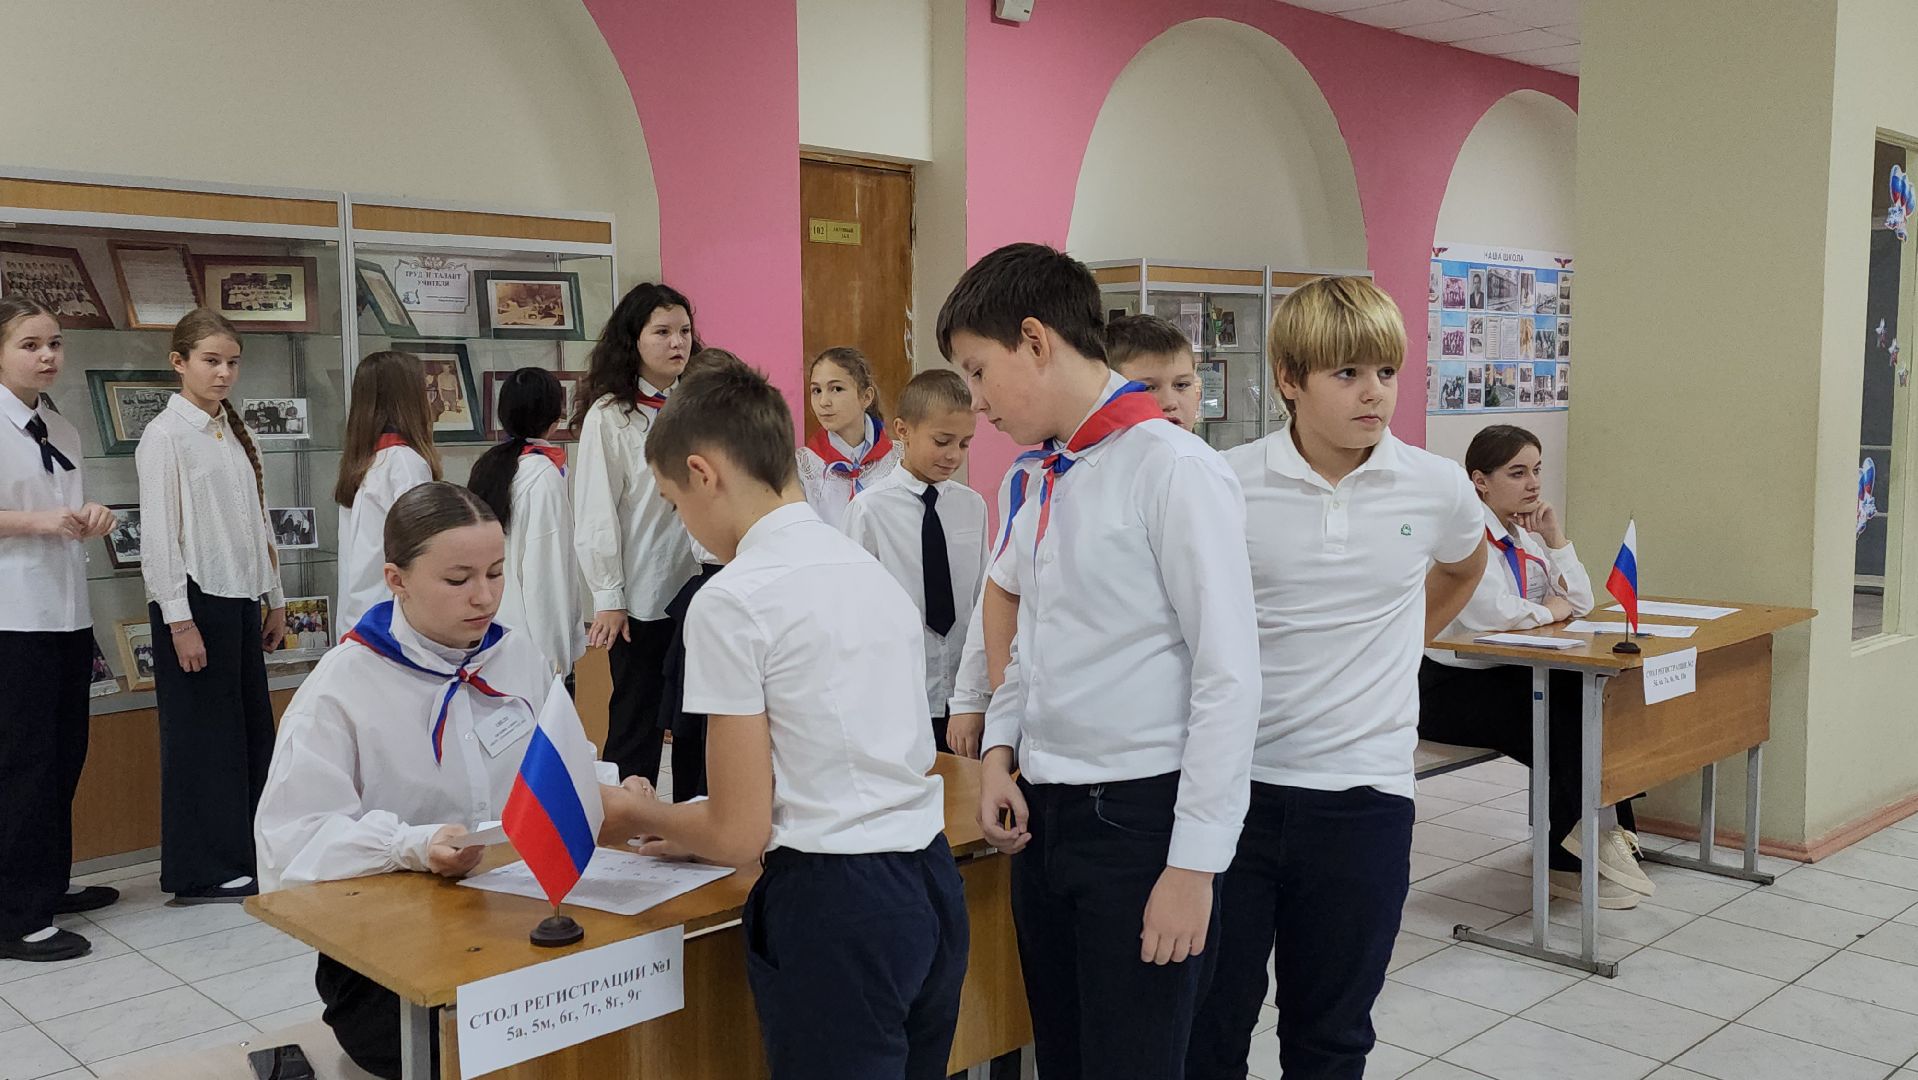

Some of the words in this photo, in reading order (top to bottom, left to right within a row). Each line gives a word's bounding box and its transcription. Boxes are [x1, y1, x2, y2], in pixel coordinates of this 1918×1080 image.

[813, 225, 825, 235] 102
[1502, 253, 1524, 262] ШКОЛА
[405, 270, 423, 279] ТРУД
[425, 271, 432, 279] И
[432, 272, 463, 280] ТАЛАНТ
[469, 1003, 519, 1030] СТОЛ
[525, 965, 646, 1013] РЕГИСТРАЦИИ
[650, 958, 671, 977] №1
[506, 1025, 527, 1041] 5а,
[532, 1018, 556, 1034] 5м,
[559, 1010, 579, 1025] 6г,
[583, 1002, 602, 1018] 7г,
[605, 994, 624, 1010] 8г,
[627, 988, 643, 1003] 9г
